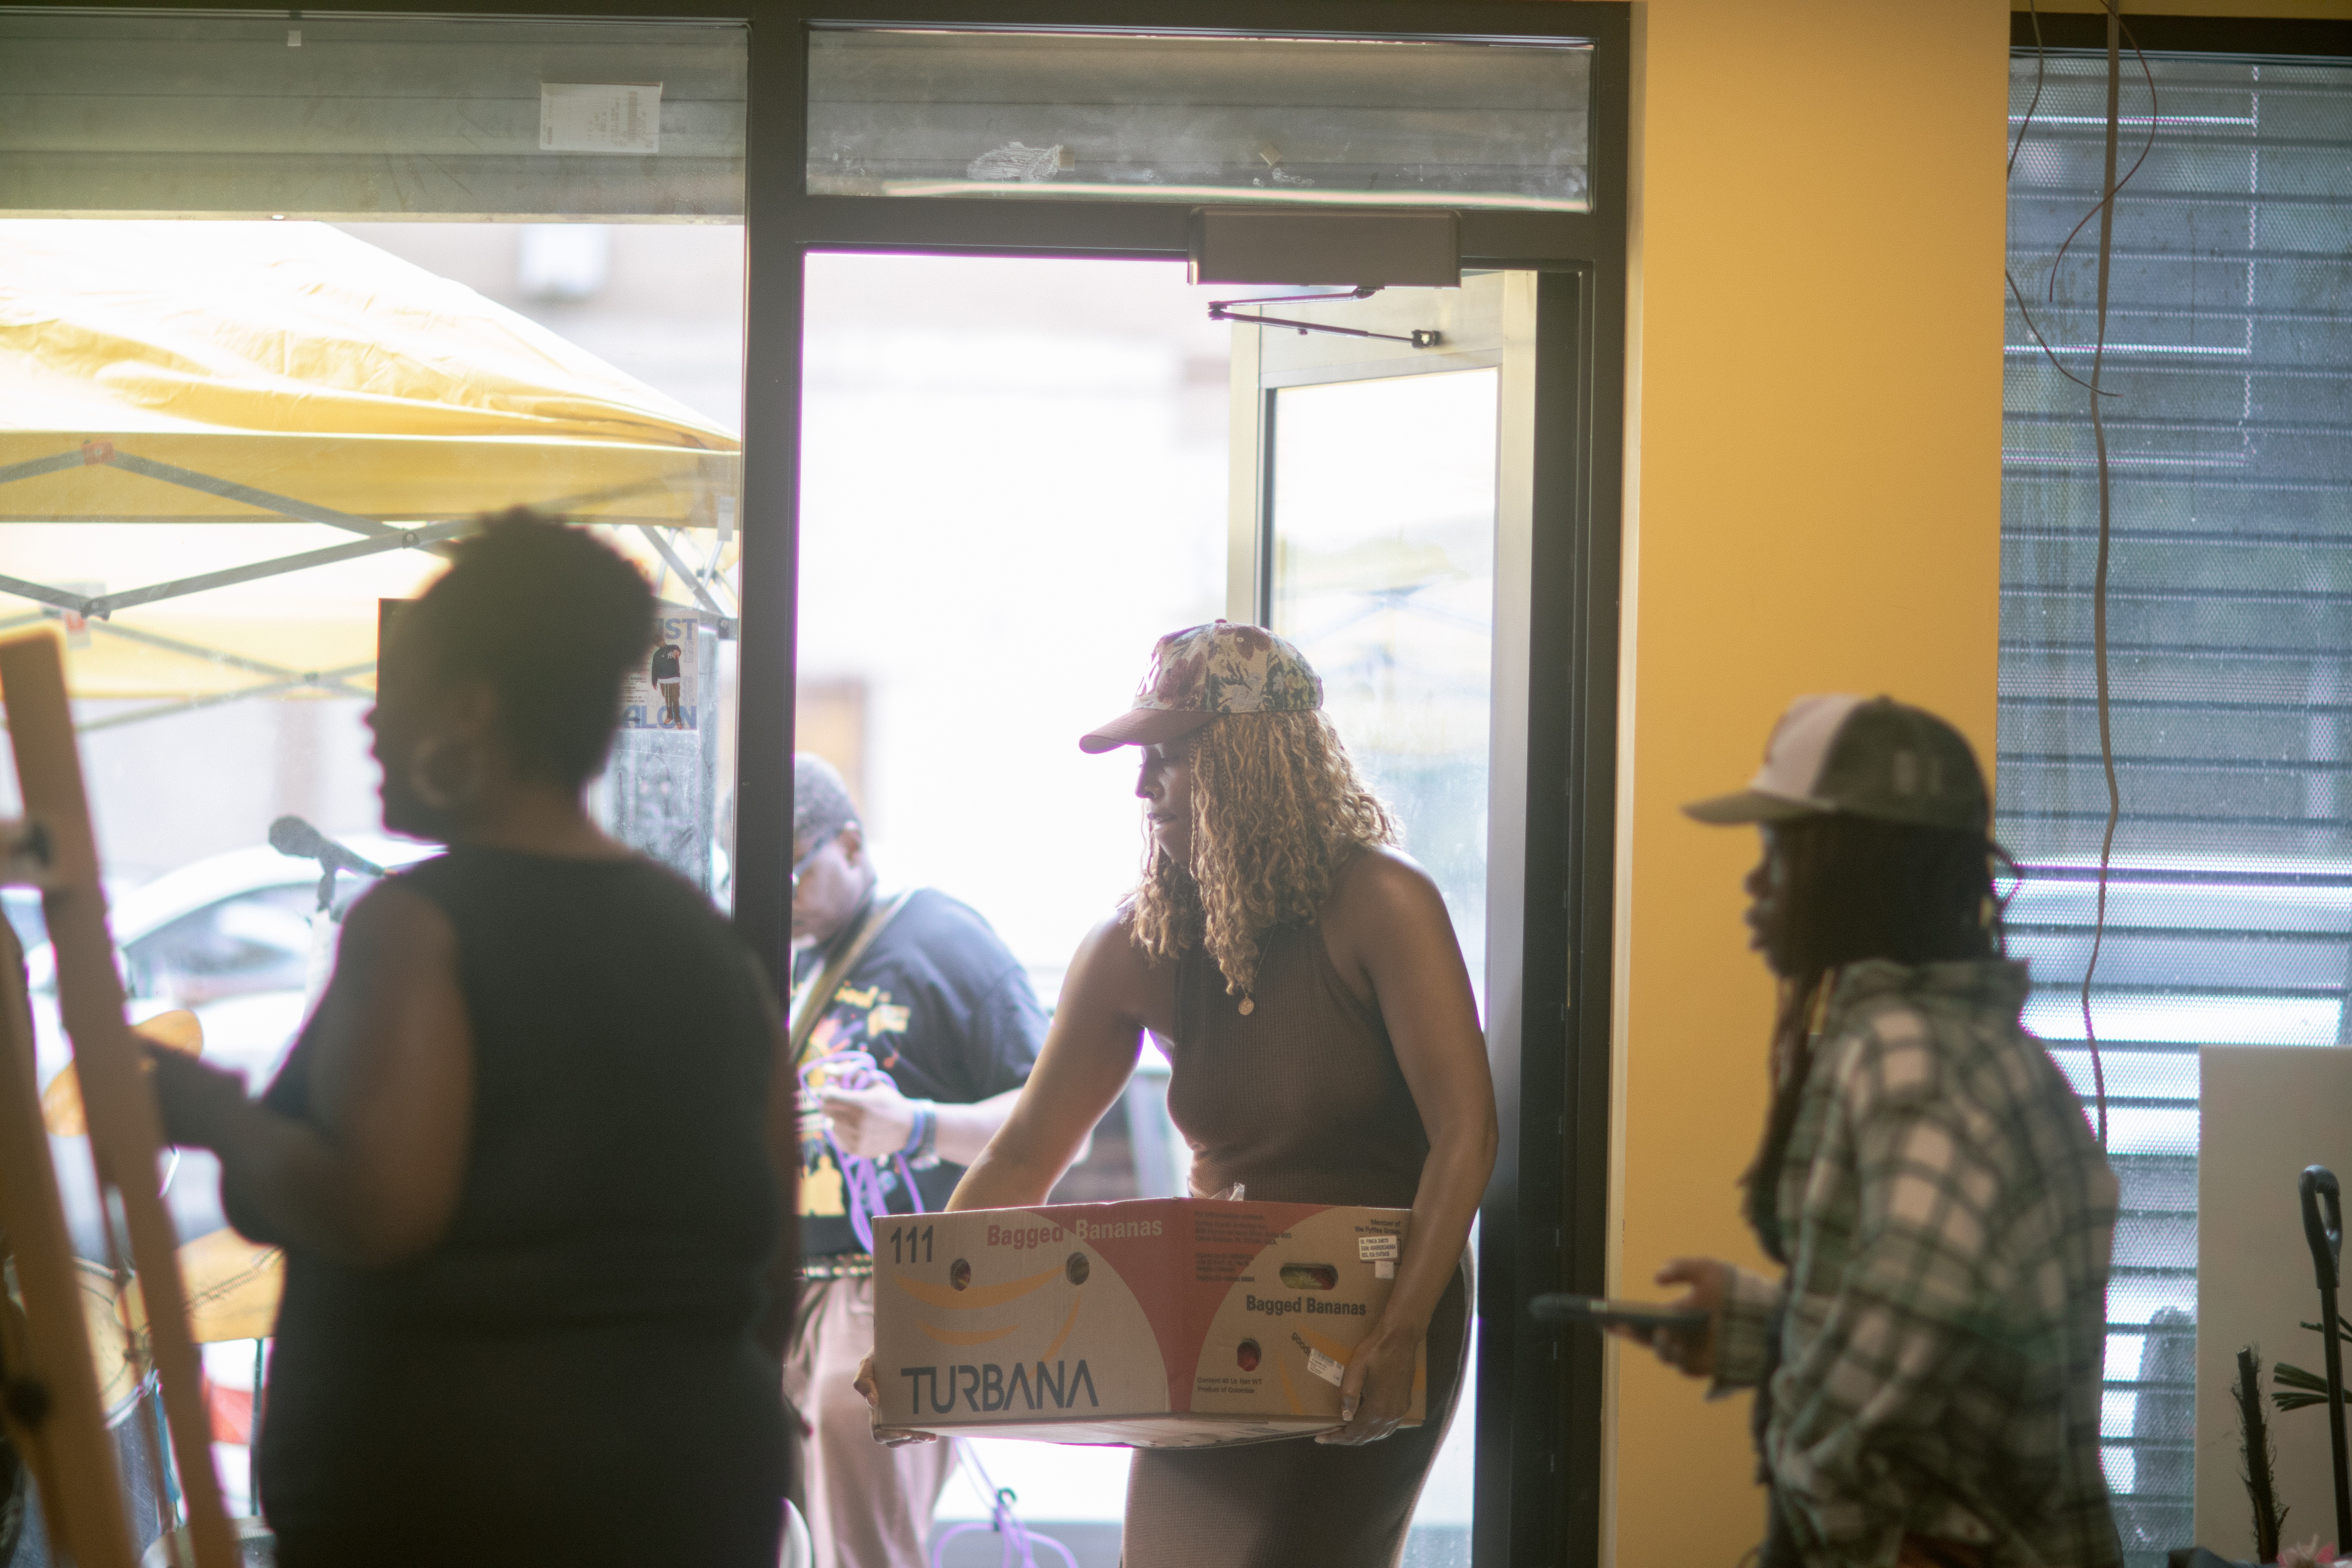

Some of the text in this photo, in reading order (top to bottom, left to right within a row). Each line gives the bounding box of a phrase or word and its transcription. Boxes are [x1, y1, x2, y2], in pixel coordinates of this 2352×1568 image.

[890, 1225, 934, 1264] 111
[987, 1218, 1163, 1250] Bagged Bananas
[1246, 1294, 1367, 1316] Bagged Bananas
[901, 1359, 1099, 1415] TURBANA
